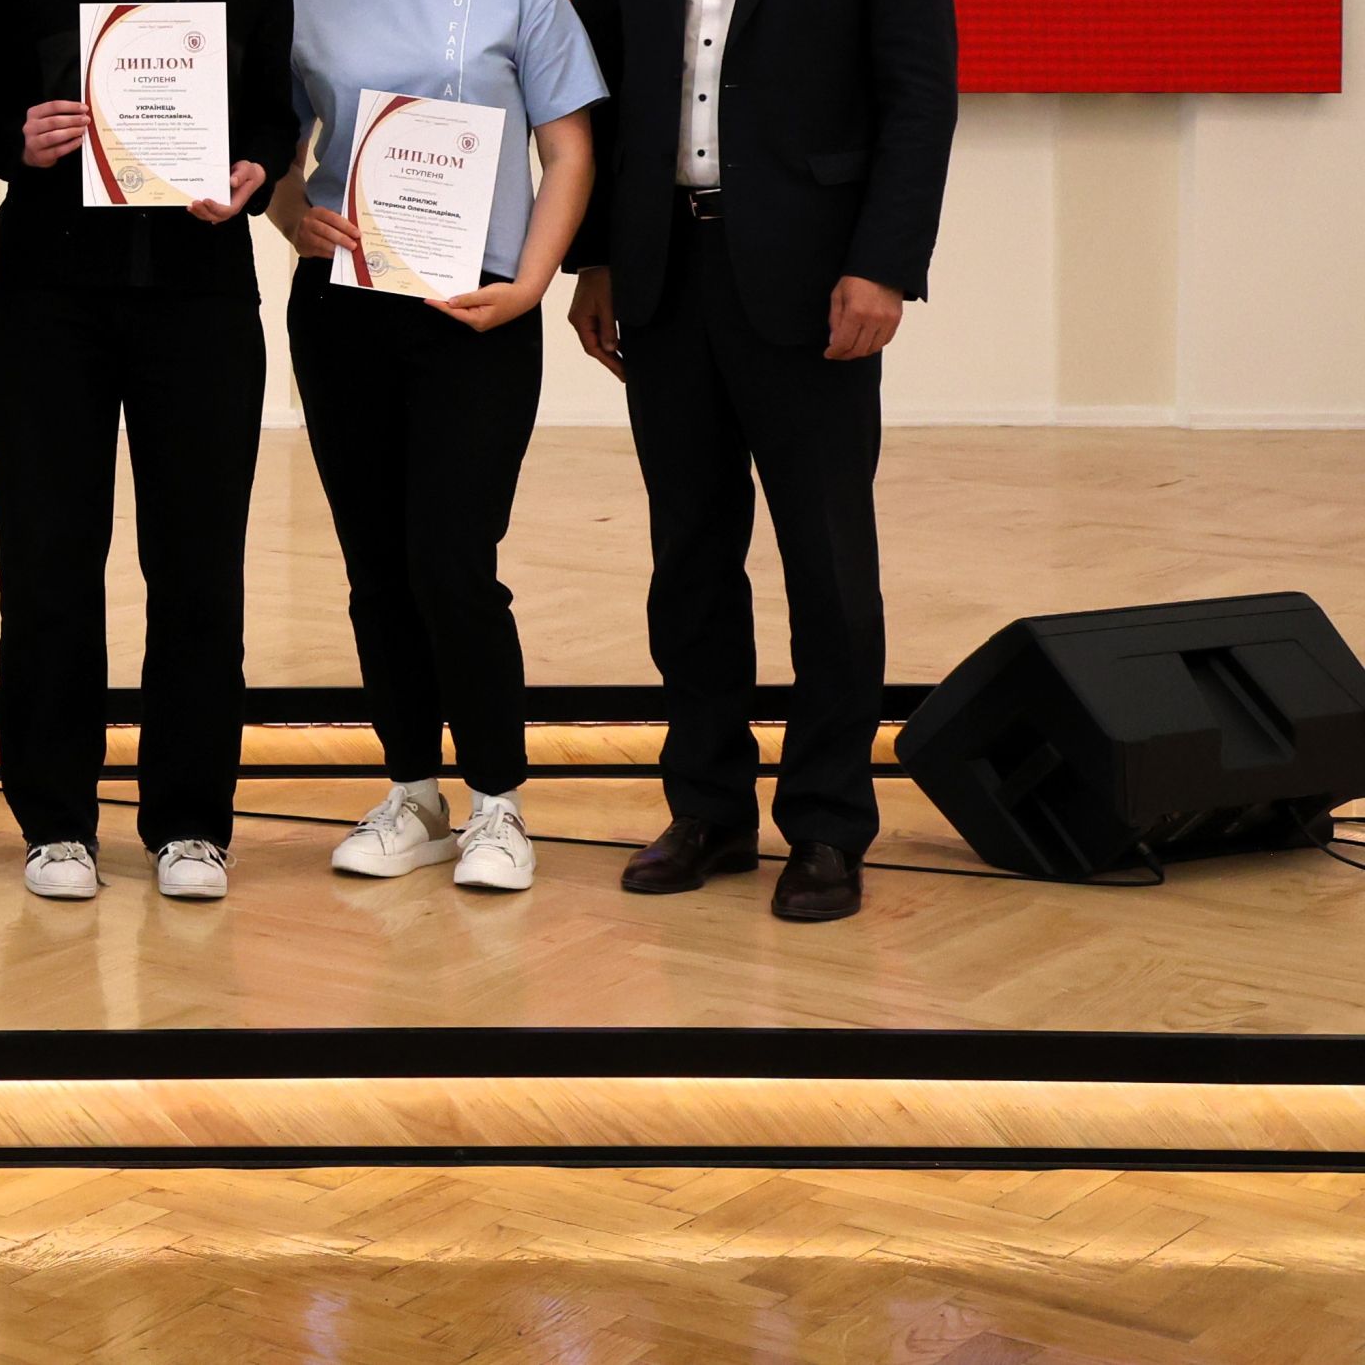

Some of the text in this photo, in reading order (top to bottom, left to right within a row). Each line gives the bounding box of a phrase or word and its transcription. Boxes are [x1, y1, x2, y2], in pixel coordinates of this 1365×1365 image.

[445, 21, 459, 61] FAR
[114, 58, 194, 71] ДИПЛОМ
[385, 147, 465, 169] ДИПЛОМ
[406, 169, 444, 179] СТУПЕНЯ
